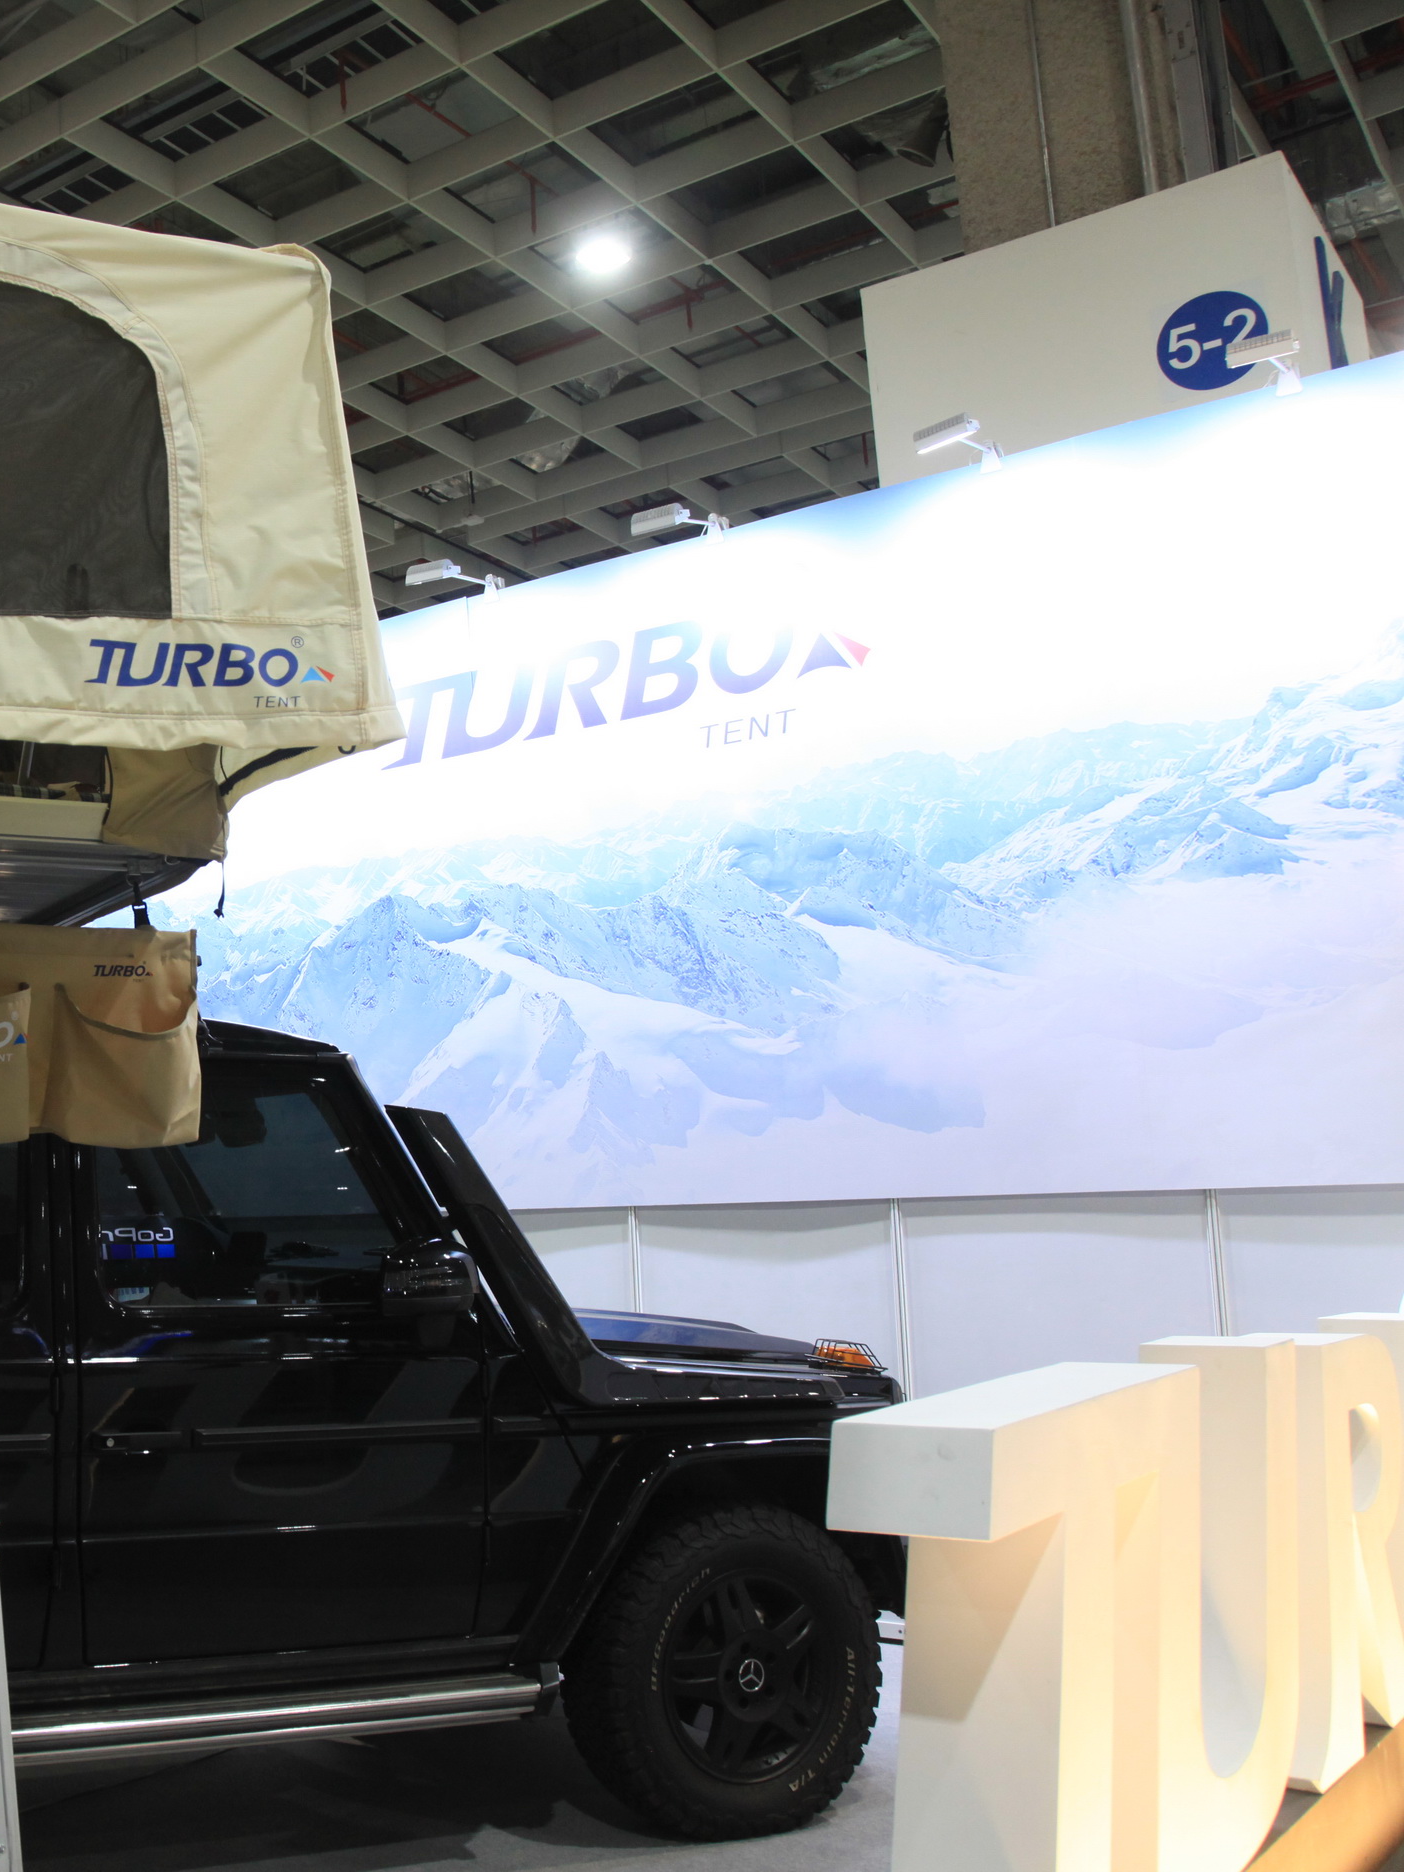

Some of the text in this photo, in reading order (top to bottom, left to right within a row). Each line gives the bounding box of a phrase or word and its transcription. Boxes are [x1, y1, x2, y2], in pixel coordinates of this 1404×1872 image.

[1168, 308, 1257, 370] 5-2
[84, 639, 299, 688] TURBO
[253, 695, 302, 709] TENT
[381, 618, 794, 771] TURBO
[699, 708, 797, 750] TENT
[92, 964, 146, 977] TURBO
[826, 1312, 1404, 1872] TUR
[788, 1646, 857, 1793] All-Terrain T/A
